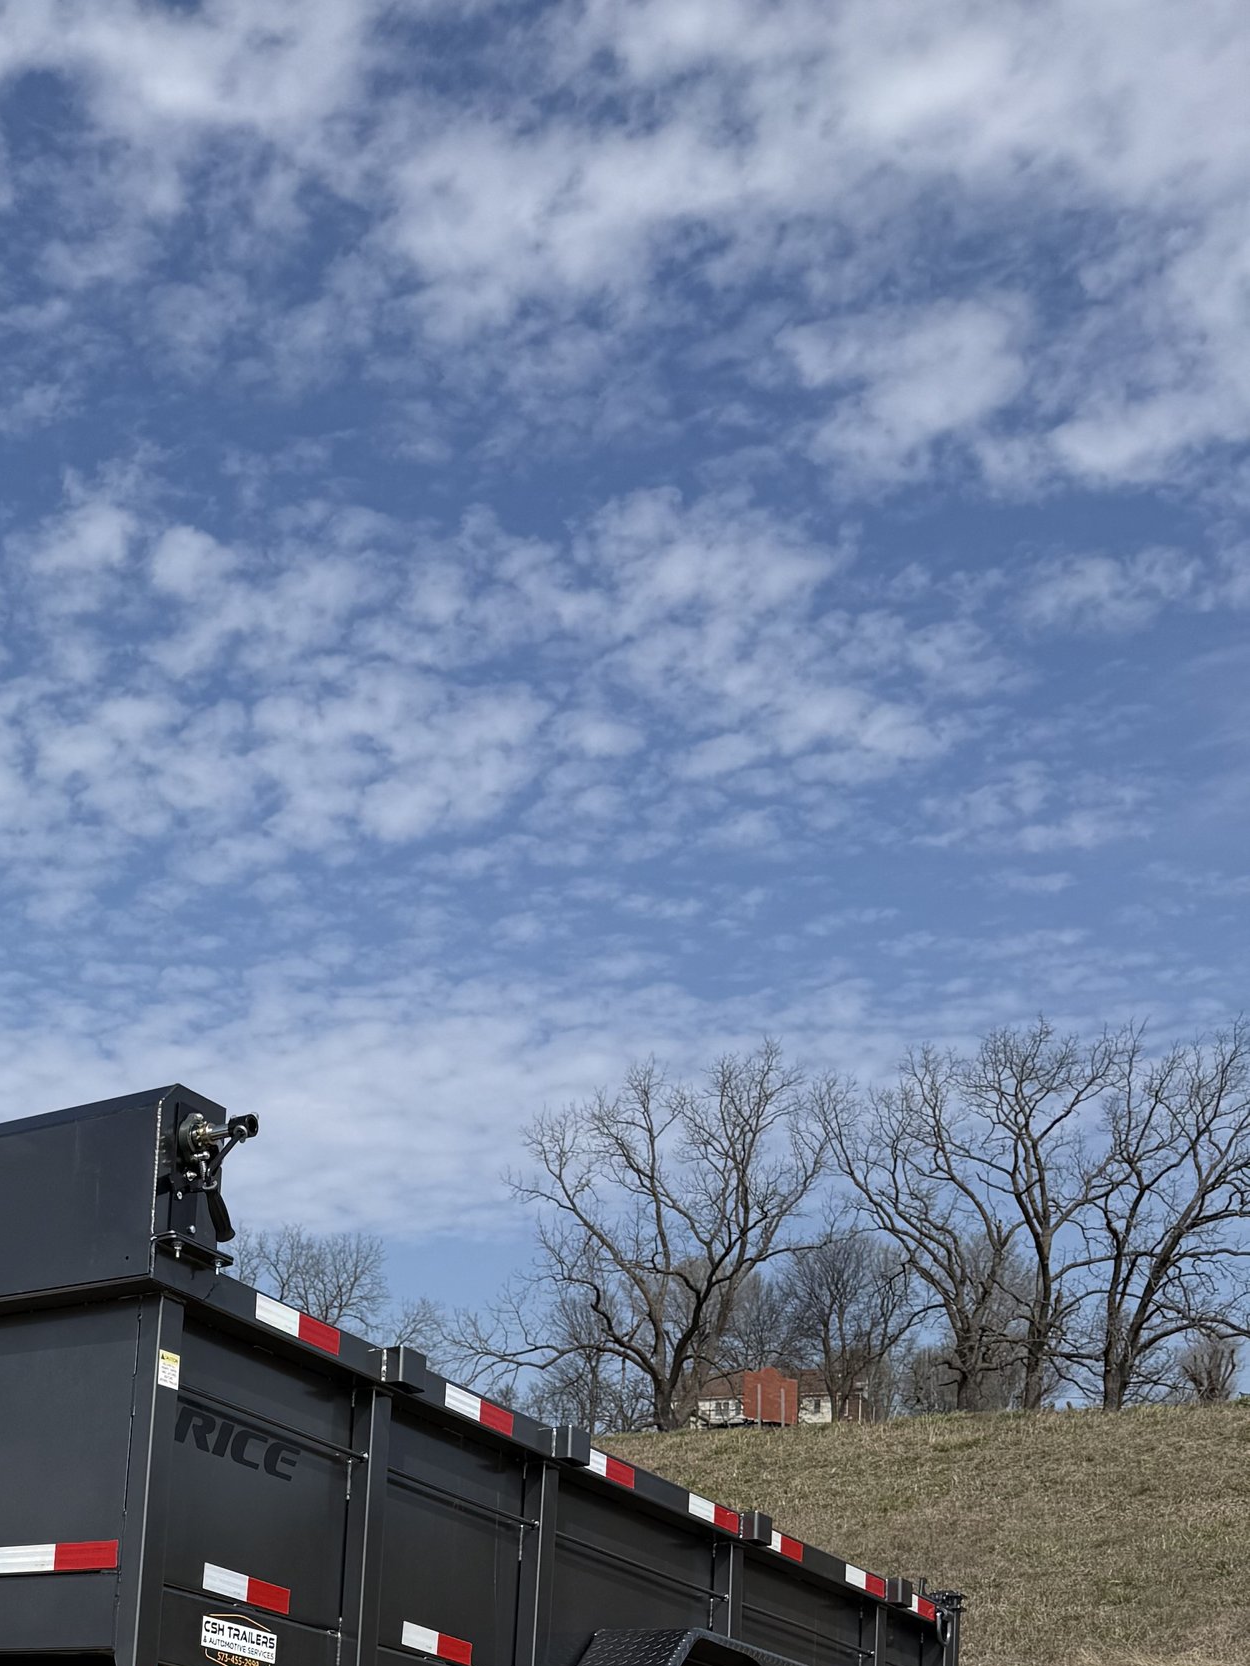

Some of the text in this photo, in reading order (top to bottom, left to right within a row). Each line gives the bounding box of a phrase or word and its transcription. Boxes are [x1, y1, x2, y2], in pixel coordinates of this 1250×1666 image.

[174, 1406, 301, 1481] RICE
[204, 1620, 275, 1649] CSH TRAILERS
[209, 1637, 246, 1653] AUTOMOTIVE
[247, 1646, 275, 1660] SERVICES
